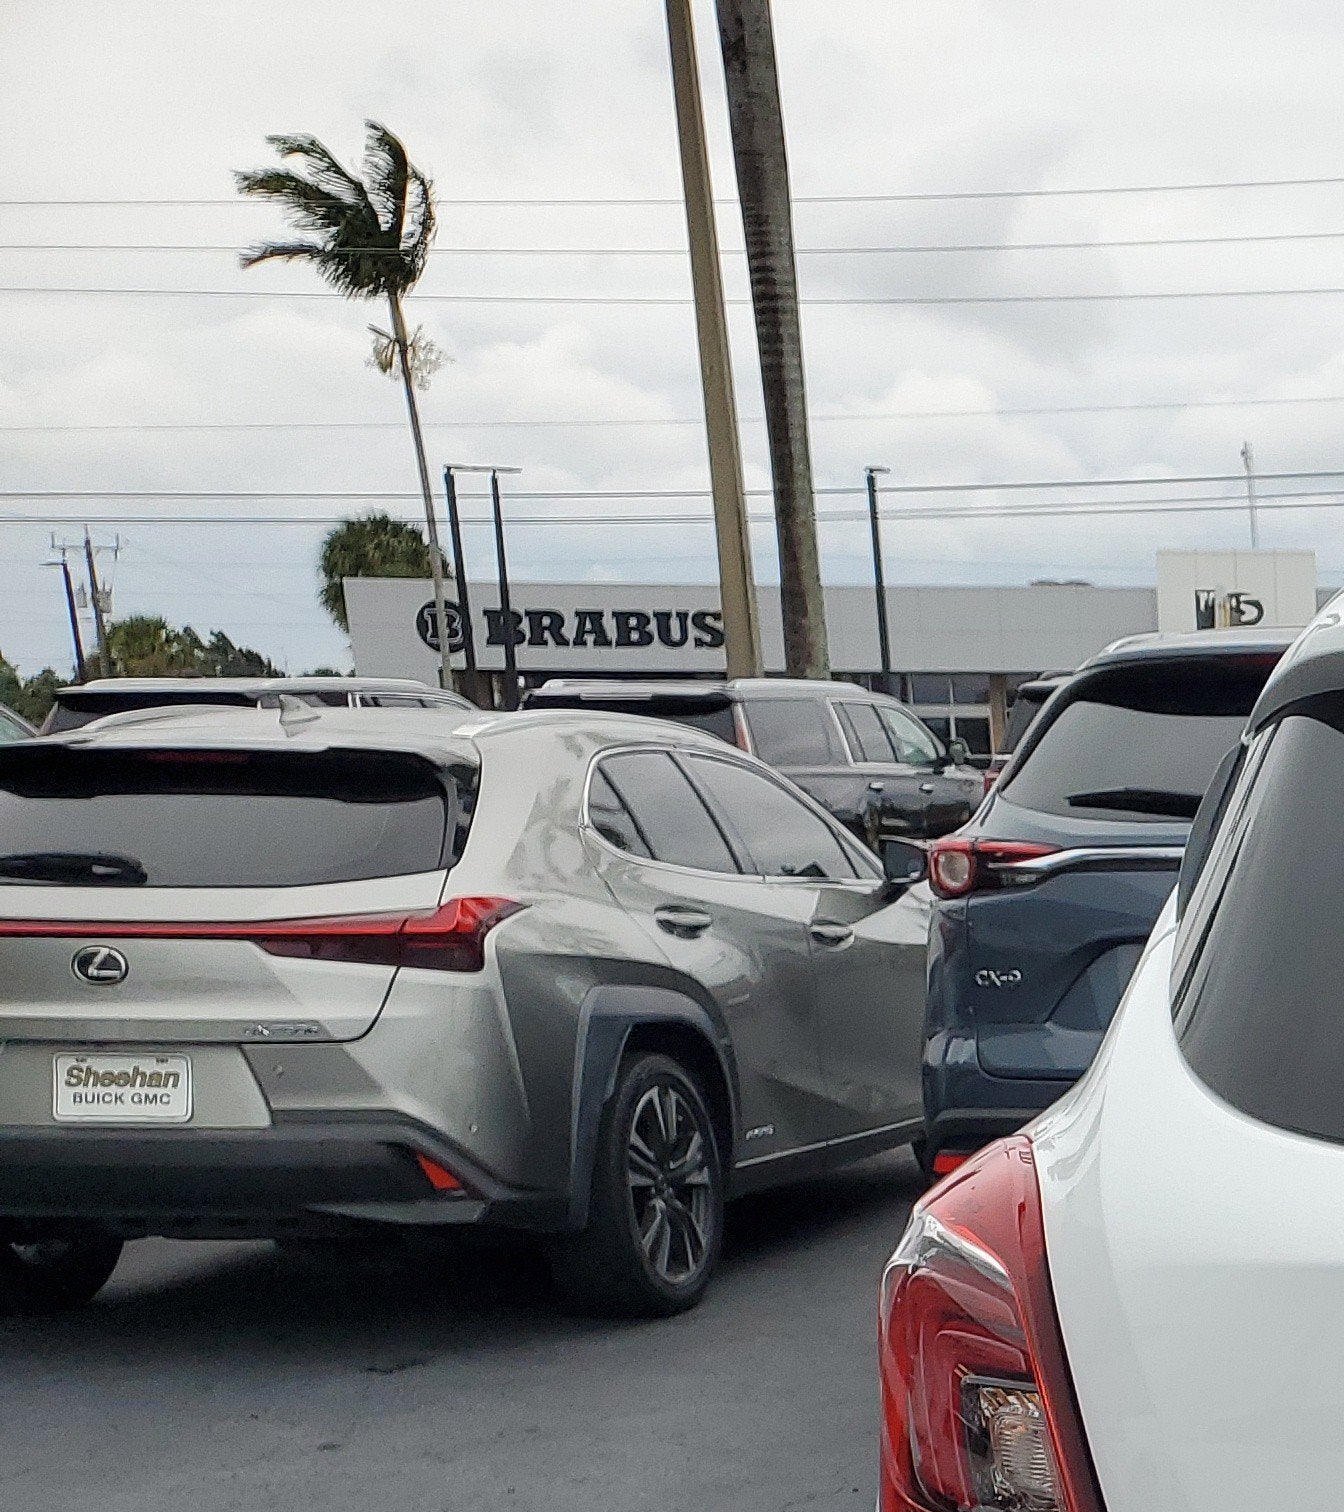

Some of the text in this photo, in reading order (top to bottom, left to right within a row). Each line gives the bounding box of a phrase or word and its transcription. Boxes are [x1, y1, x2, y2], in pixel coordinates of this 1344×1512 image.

[482, 609, 726, 648] BRABUS
[65, 1066, 179, 1088] Sheehan
[72, 1092, 171, 1105] BUICK GMC
